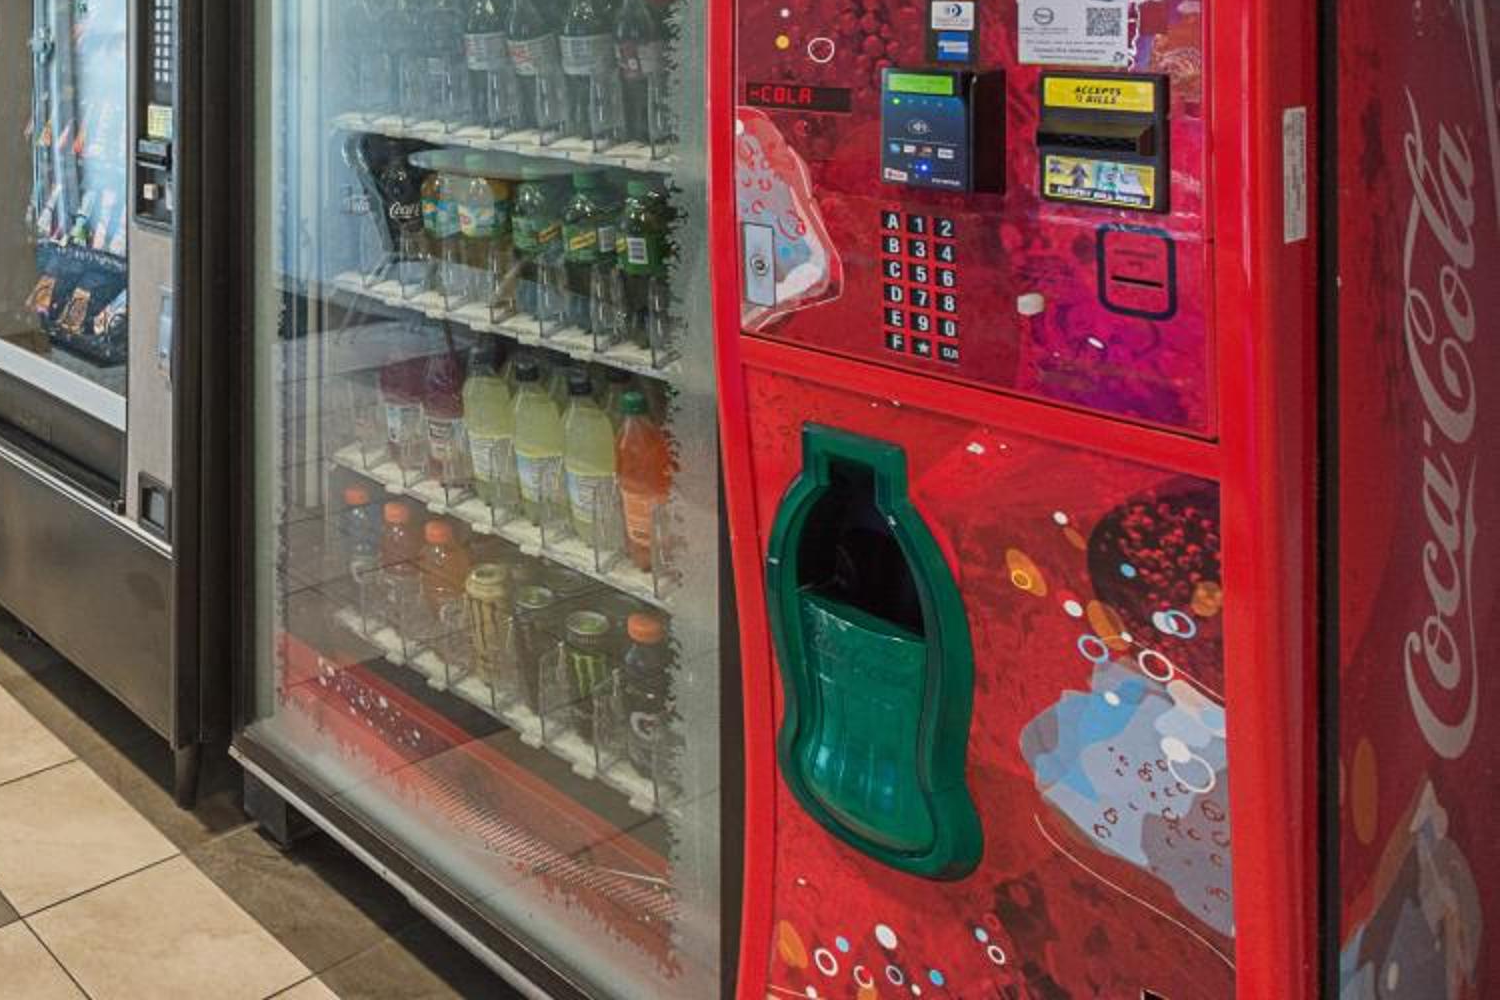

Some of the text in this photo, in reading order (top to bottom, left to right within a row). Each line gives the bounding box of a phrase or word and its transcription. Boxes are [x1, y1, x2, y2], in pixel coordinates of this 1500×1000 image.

[887, 213, 952, 237] A 1 2
[888, 237, 952, 262] B 3 4
[889, 261, 954, 288] C 5 6
[890, 285, 955, 313] D 7 8
[891, 309, 902, 327] E
[917, 314, 929, 332] 9
[892, 333, 903, 350] F
[1403, 86, 1477, 760] Coca-Cola
